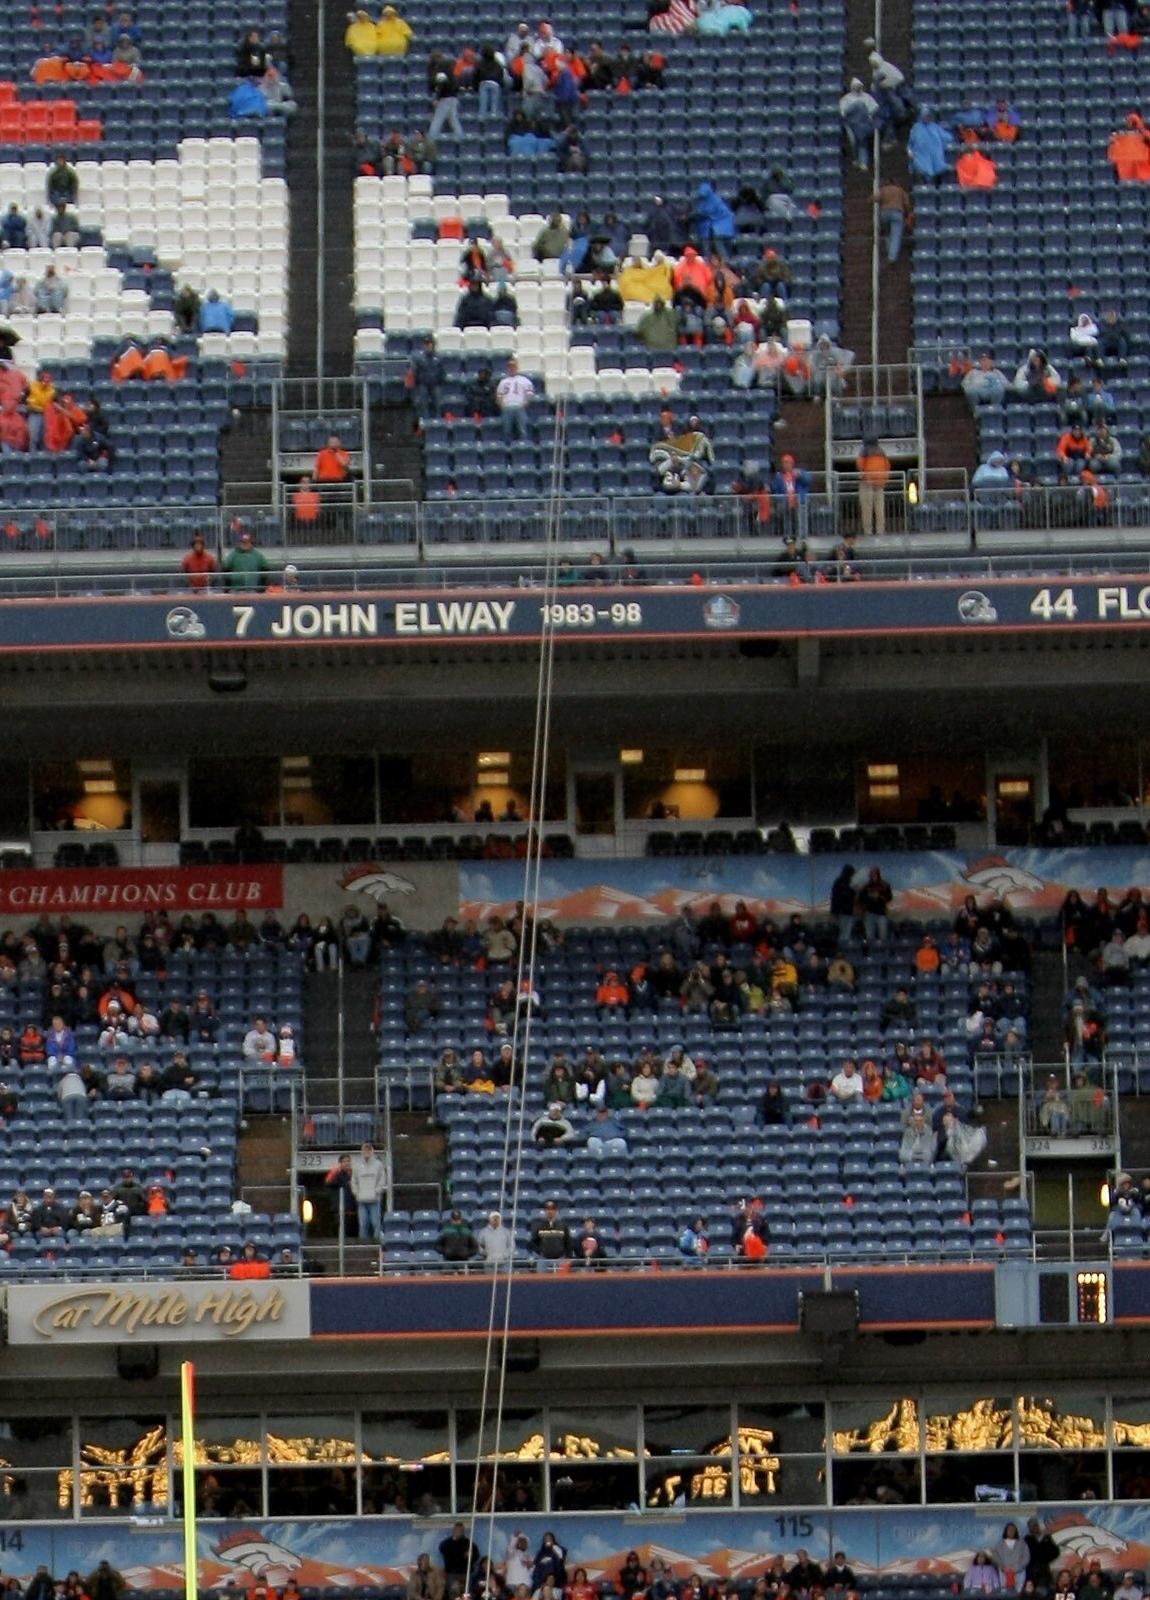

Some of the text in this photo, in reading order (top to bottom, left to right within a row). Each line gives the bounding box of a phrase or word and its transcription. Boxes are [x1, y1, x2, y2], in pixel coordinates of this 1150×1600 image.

[1030, 587, 1078, 620] 44
[232, 601, 642, 637] 7 JOHN ELWAY 1983-98
[10, 882, 176, 906] CHAMPIONS
[188, 880, 261, 902] CLUB
[302, 1156, 322, 1166] 323
[90, 1289, 187, 1335] Mile
[194, 1285, 285, 1336] High
[775, 1513, 814, 1537] 115
